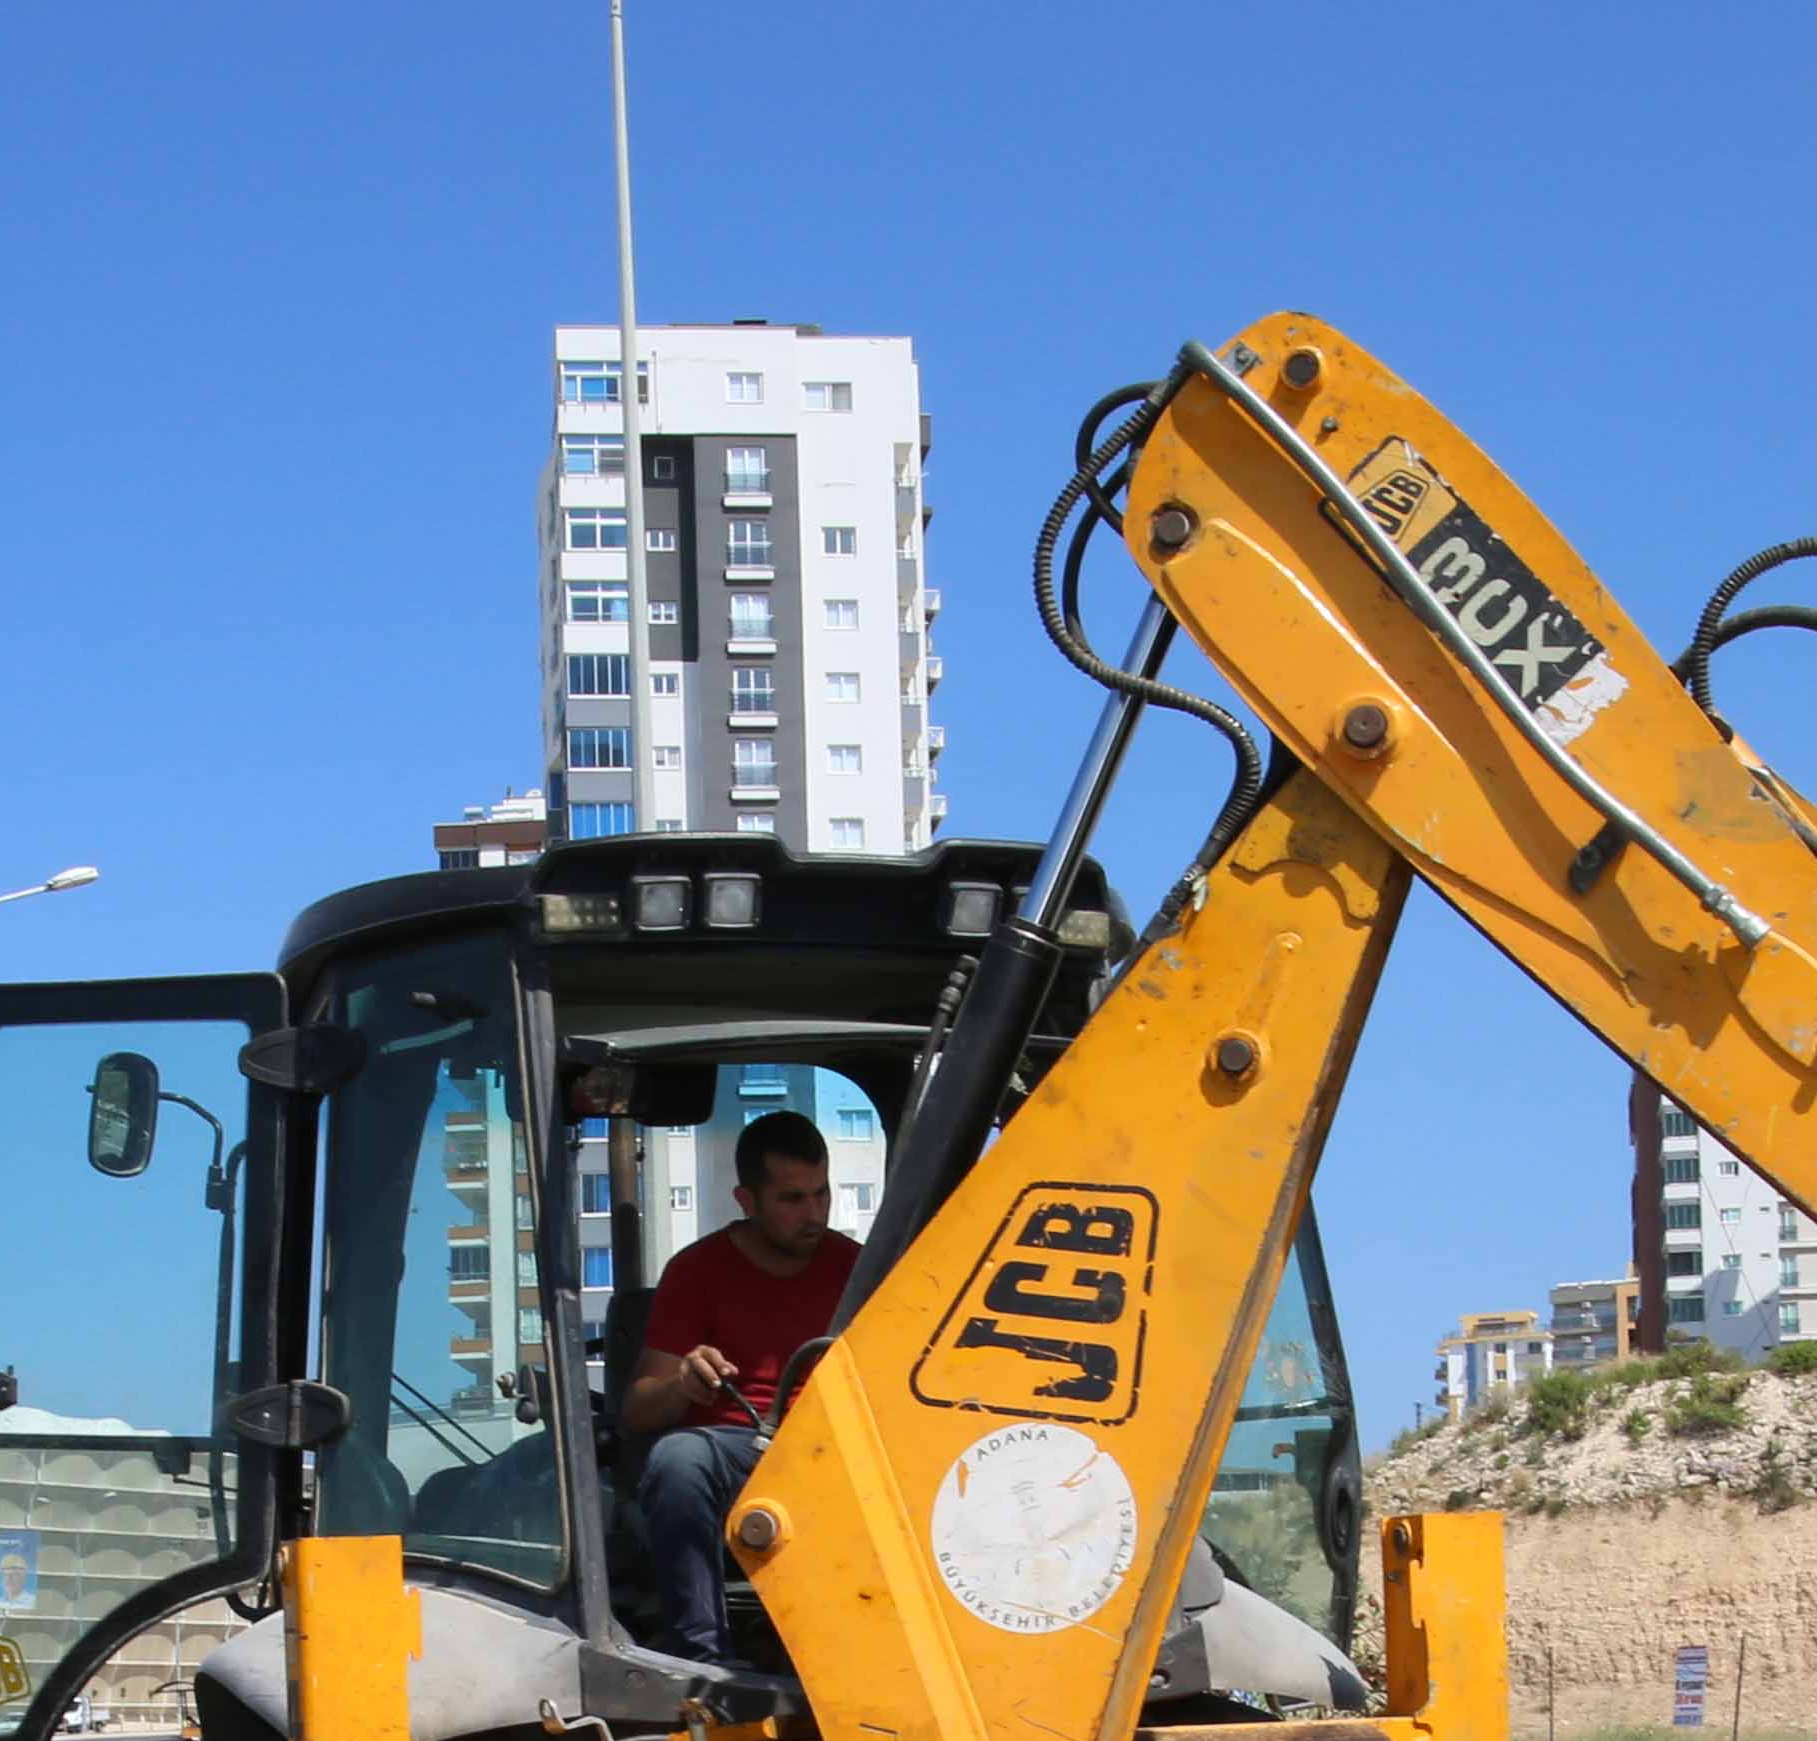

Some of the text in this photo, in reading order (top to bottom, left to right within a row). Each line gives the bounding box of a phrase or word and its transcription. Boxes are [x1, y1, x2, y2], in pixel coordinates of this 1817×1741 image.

[1361, 475, 1424, 536] JCB
[1419, 536, 1577, 699] 3CX
[954, 1203, 1134, 1403] JCB
[975, 1428, 1049, 1462] ADANA
